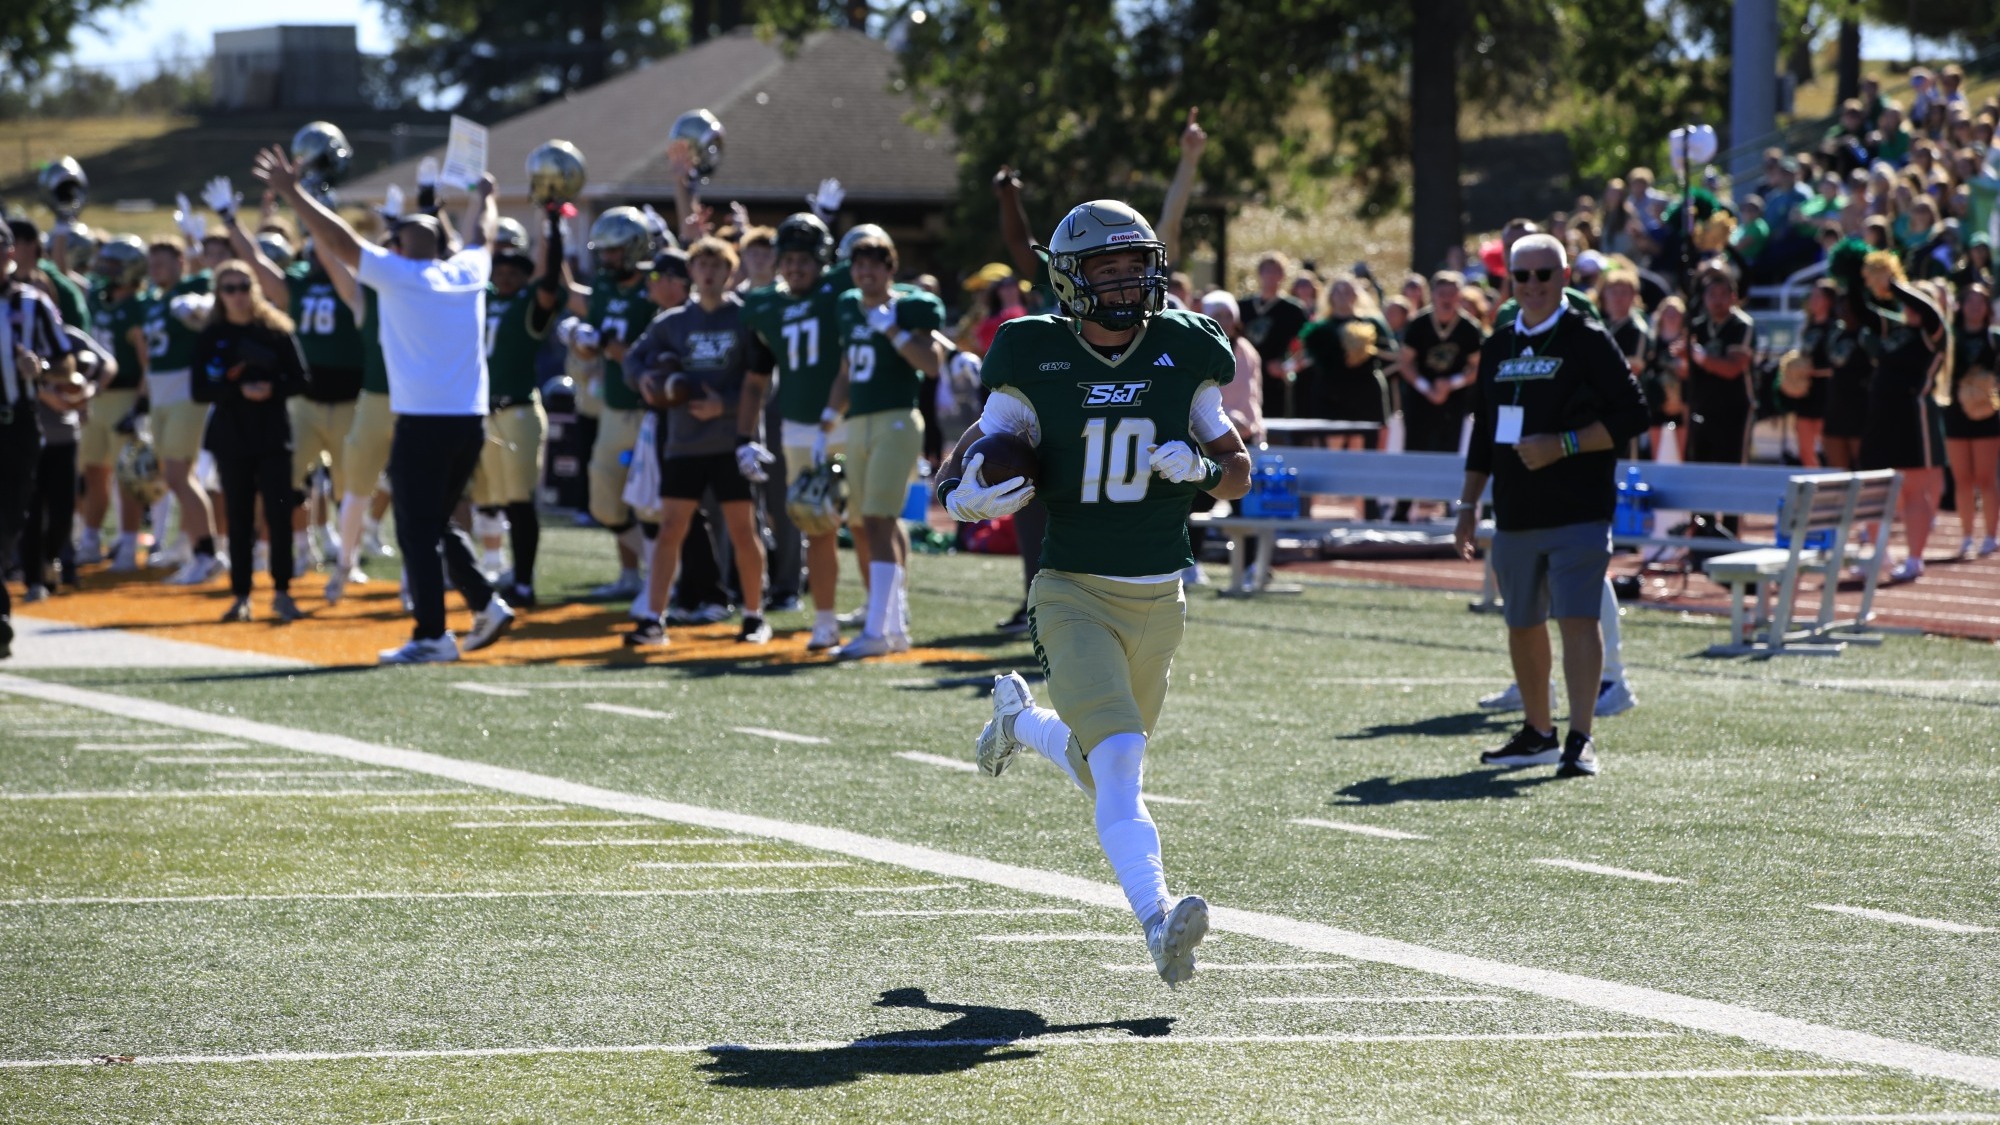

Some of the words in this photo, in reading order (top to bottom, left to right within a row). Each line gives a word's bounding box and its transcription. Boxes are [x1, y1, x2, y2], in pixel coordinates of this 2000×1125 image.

[1039, 361, 1071, 371] GLVC
[1086, 383, 1146, 405] S&T
[1080, 416, 1157, 504] 10
